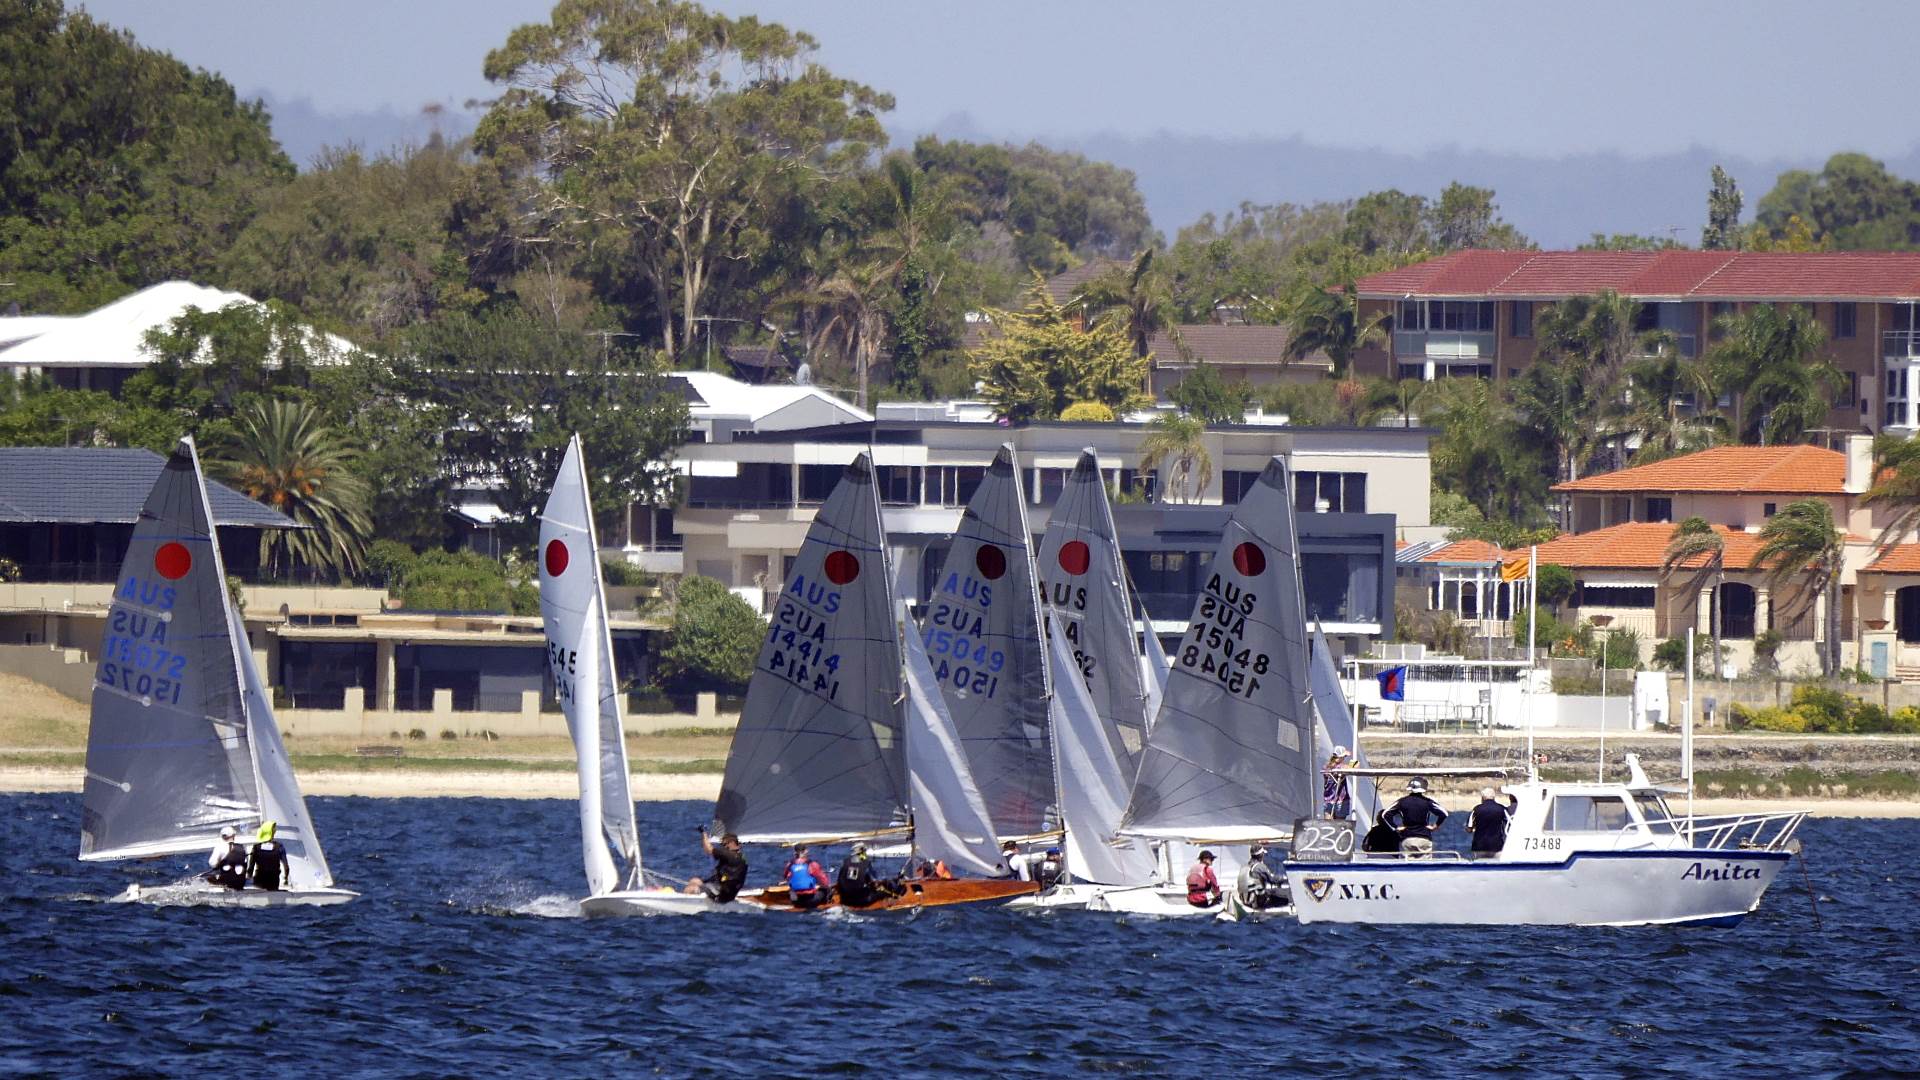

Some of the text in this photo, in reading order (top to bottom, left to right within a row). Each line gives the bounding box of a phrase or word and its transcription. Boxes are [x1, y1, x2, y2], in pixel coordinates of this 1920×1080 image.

[120, 577, 177, 609] AUS
[790, 575, 841, 613] AUS
[944, 572, 992, 608] AUS
[1207, 573, 1257, 616] AUS
[105, 635, 187, 679] 15072
[770, 624, 841, 675] 14414
[924, 628, 1005, 673] 15049
[1193, 622, 1271, 675] 15048
[1300, 826, 1354, 855] 230
[1523, 837, 1561, 850] 73488
[1681, 862, 1761, 881] Anita
[1339, 884, 1400, 900] N.Y.C.
